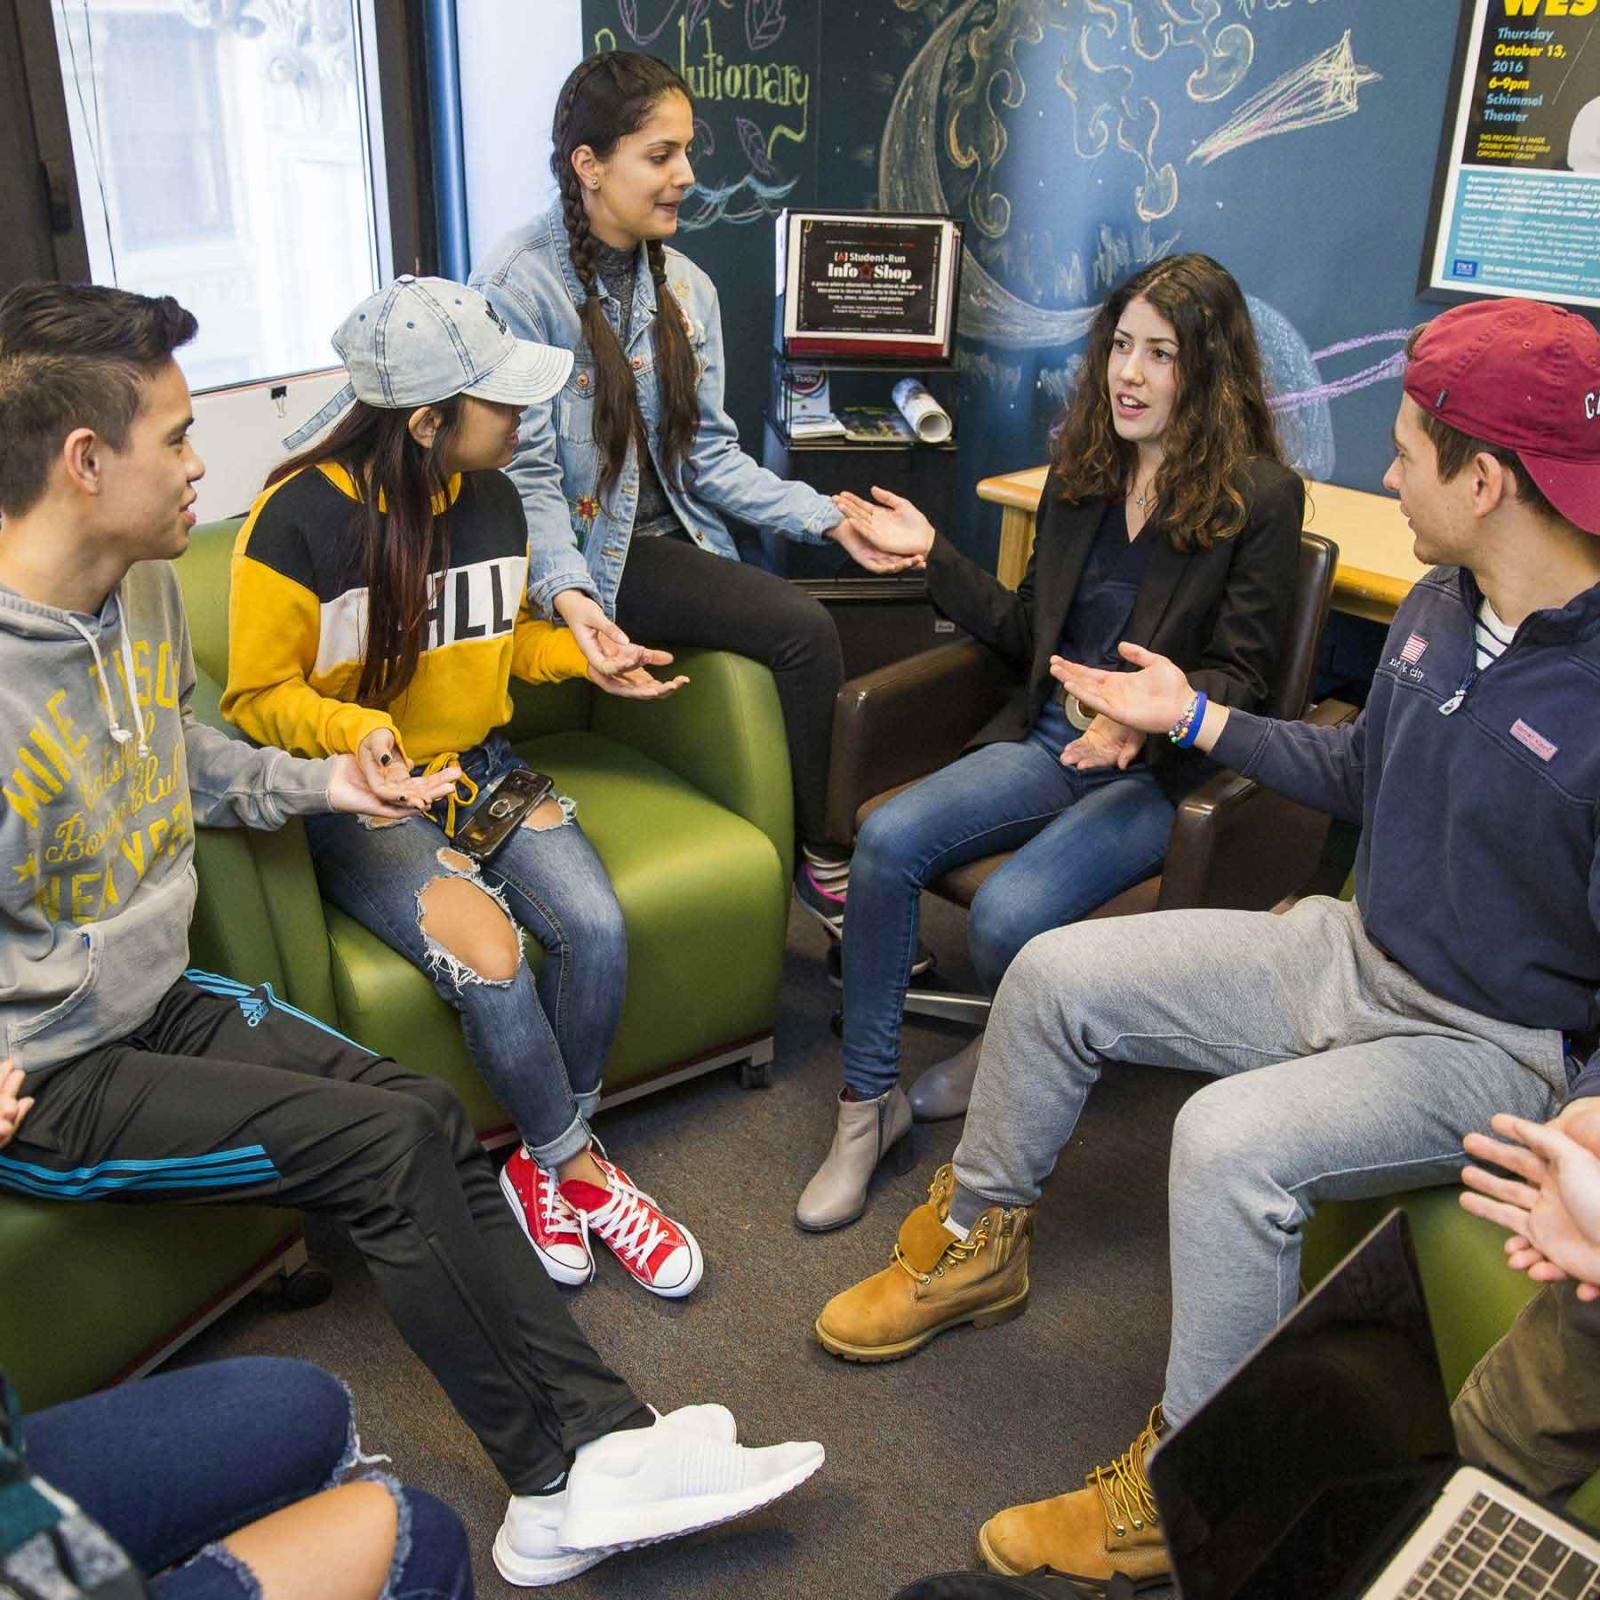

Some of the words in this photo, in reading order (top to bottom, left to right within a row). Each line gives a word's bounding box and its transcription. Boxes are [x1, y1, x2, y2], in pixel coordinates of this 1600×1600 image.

[1497, 27, 1555, 43] Thursday
[1494, 44, 1544, 57] October
[1547, 44, 1567, 59] 13,
[1491, 60, 1524, 73] 2016
[1485, 94, 1543, 106] Schimmel
[1483, 109, 1529, 122] Theater
[849, 252, 906, 263] Student-Run
[828, 262, 859, 278] Info
[874, 264, 912, 283] Shop
[88, 639, 179, 722] TYSO
